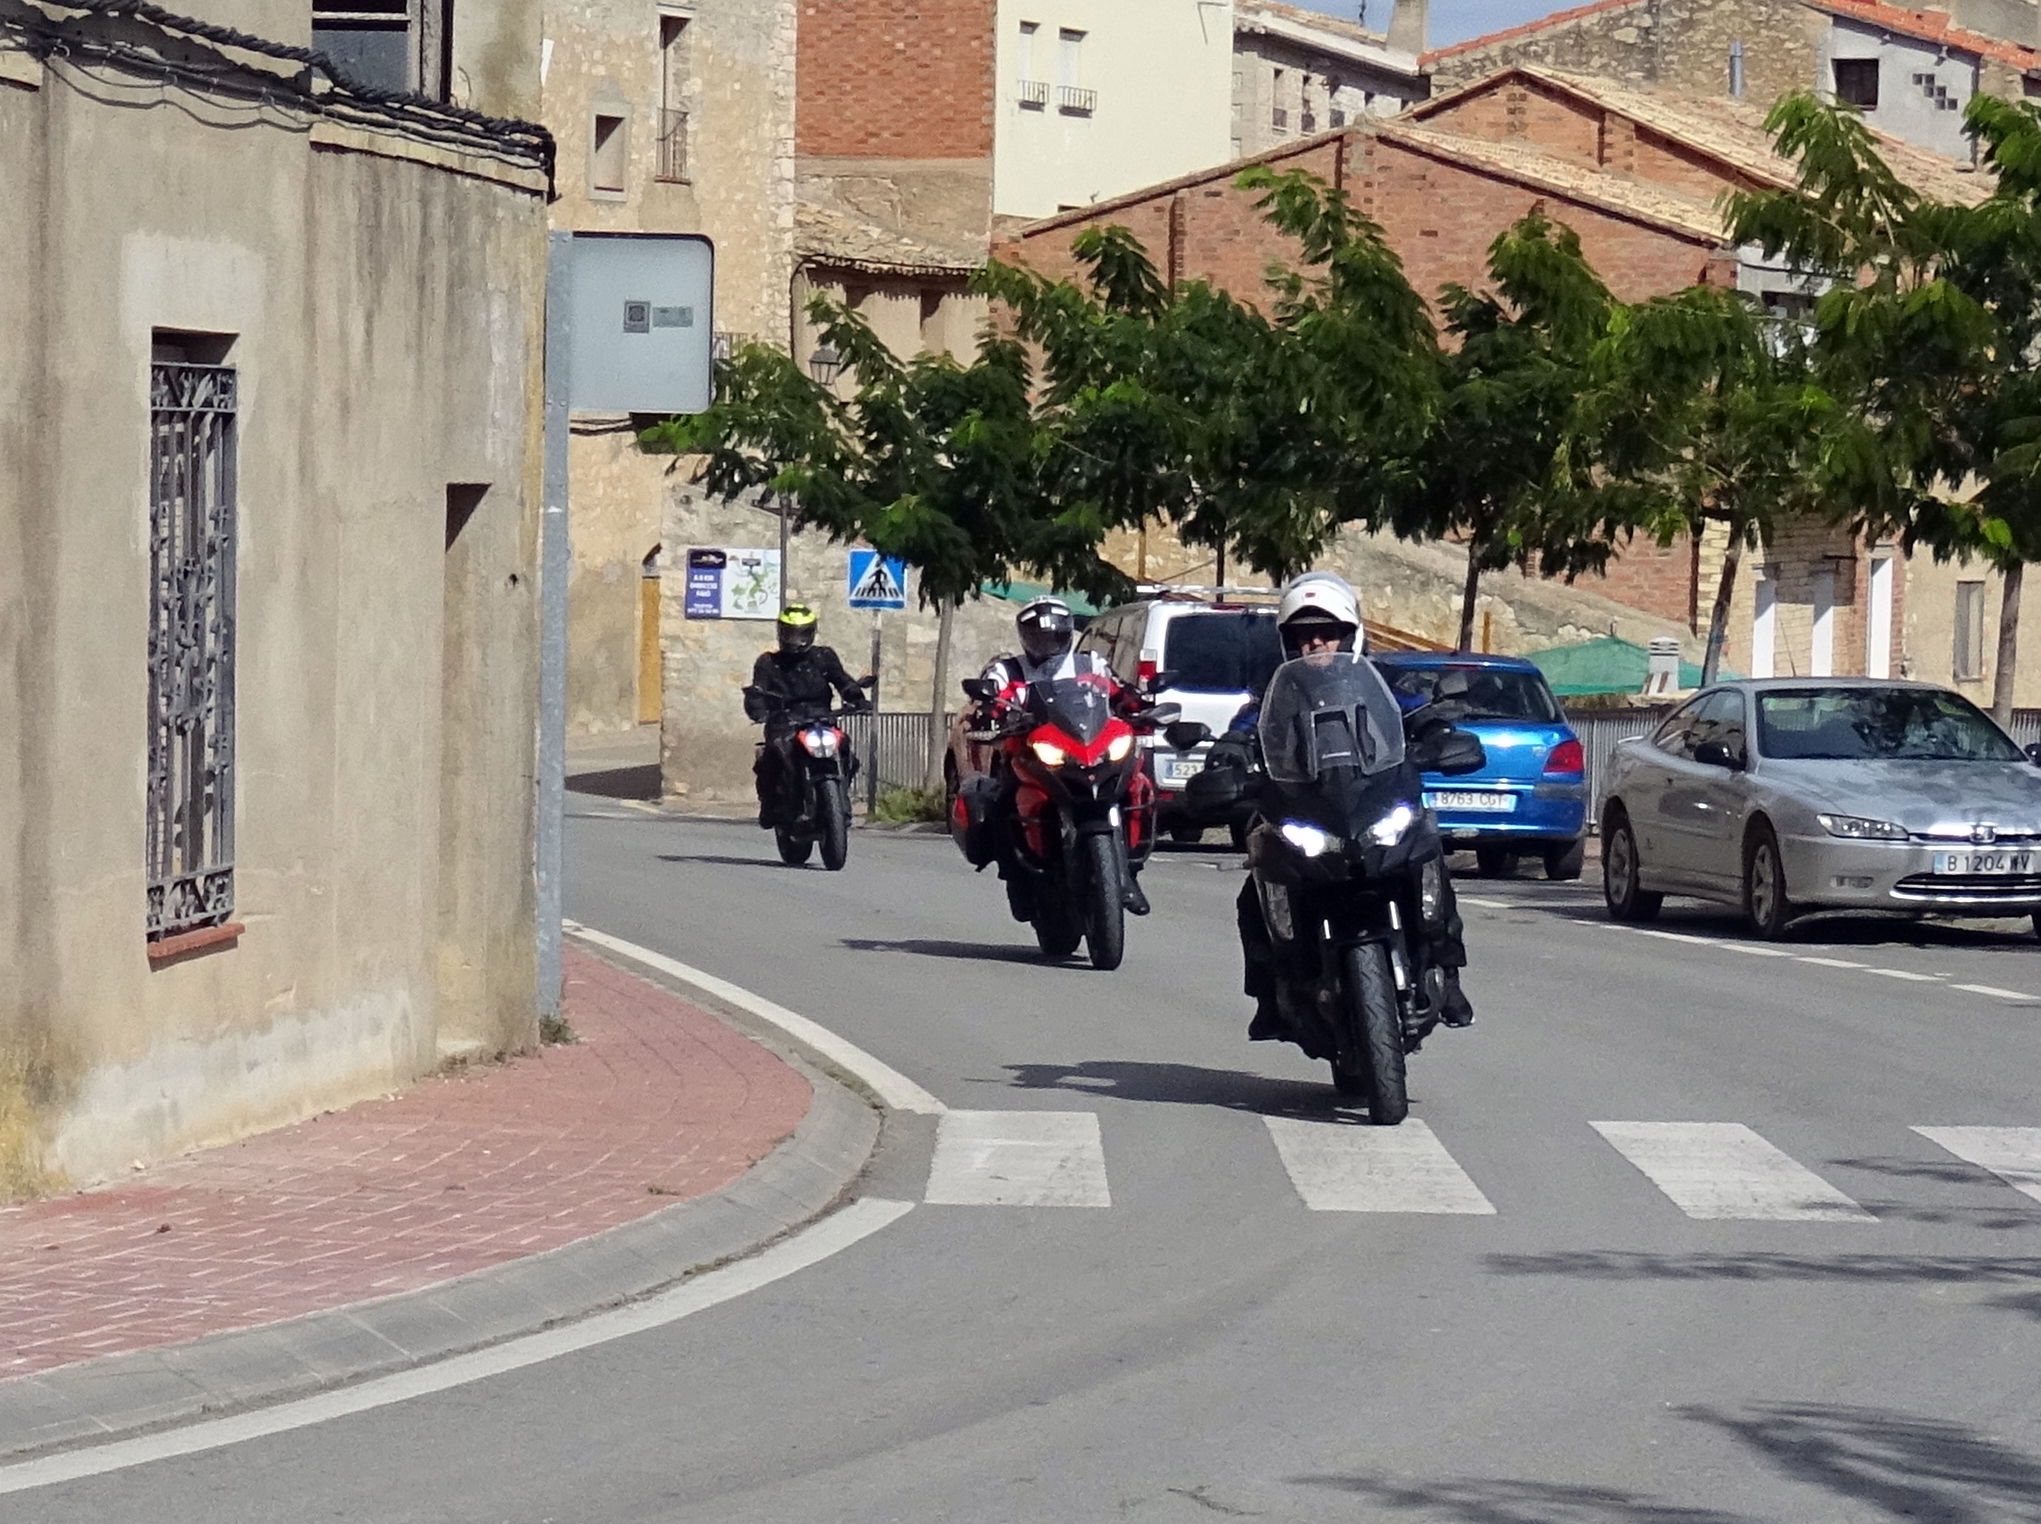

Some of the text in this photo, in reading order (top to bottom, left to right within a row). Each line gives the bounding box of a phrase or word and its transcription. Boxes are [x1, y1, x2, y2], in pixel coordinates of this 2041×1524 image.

[1175, 763, 1204, 776] 523
[1440, 793, 1474, 806] 8763
[1947, 855, 1957, 872] B
[1964, 855, 2005, 871] 1204
